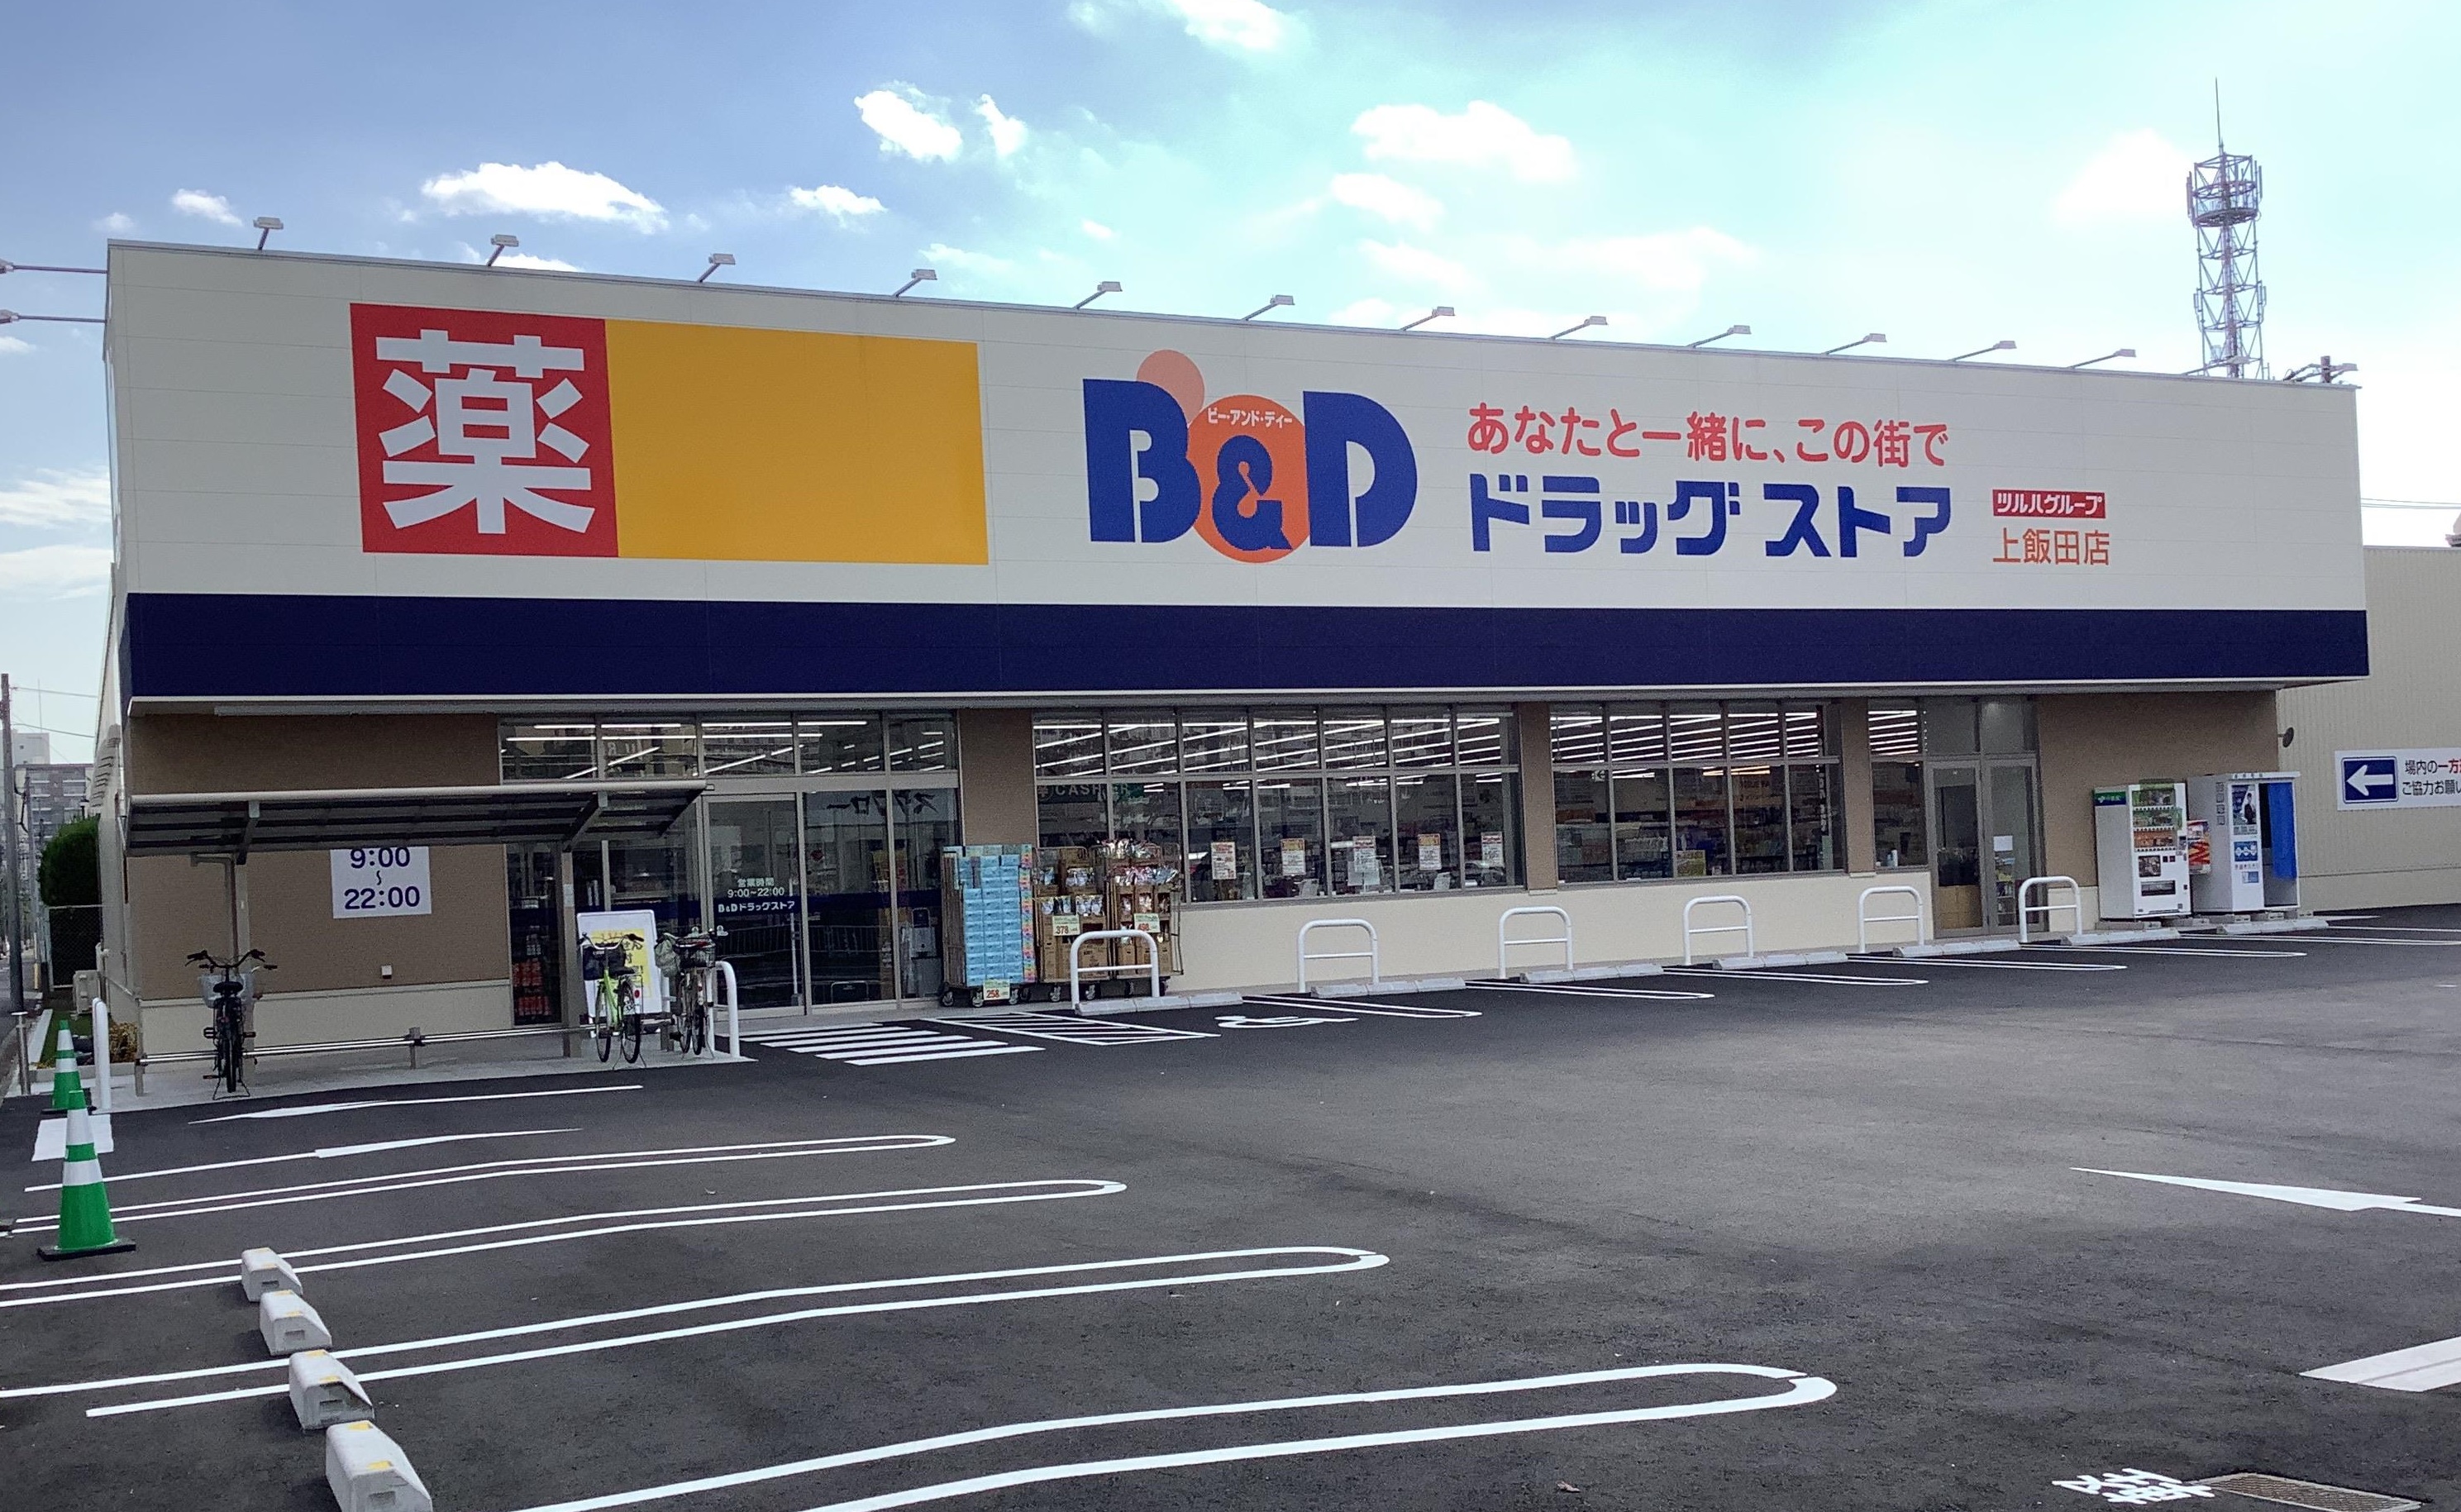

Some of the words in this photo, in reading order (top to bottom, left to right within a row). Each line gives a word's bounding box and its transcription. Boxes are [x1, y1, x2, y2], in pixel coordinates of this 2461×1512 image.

[375, 328, 595, 534] 薬
[1467, 401, 1948, 467] あなたと一緒に、この街で
[1083, 378, 1418, 551] B&D
[1996, 492, 2103, 515] ツルハグループ
[1992, 527, 2110, 565] 上飯田店
[2405, 759, 2461, 775] 場内の一方
[1055, 783, 1130, 796] CASHER
[351, 847, 411, 869] 9:00
[344, 886, 420, 909] 22:00
